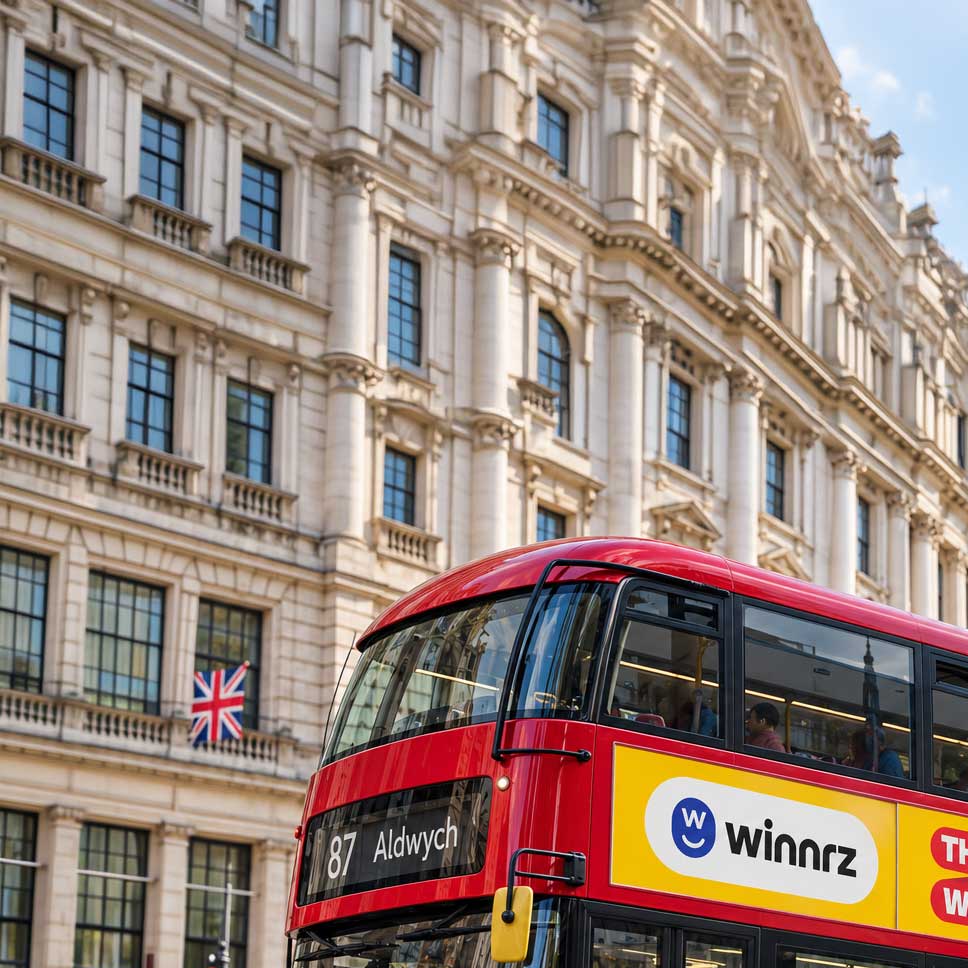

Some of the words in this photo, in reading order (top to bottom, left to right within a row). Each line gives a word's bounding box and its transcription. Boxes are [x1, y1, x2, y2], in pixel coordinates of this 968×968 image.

[327, 831, 357, 879] 87
[373, 816, 458, 863] Aldwych
[681, 807, 707, 830] W
[725, 818, 857, 878] winnrz
